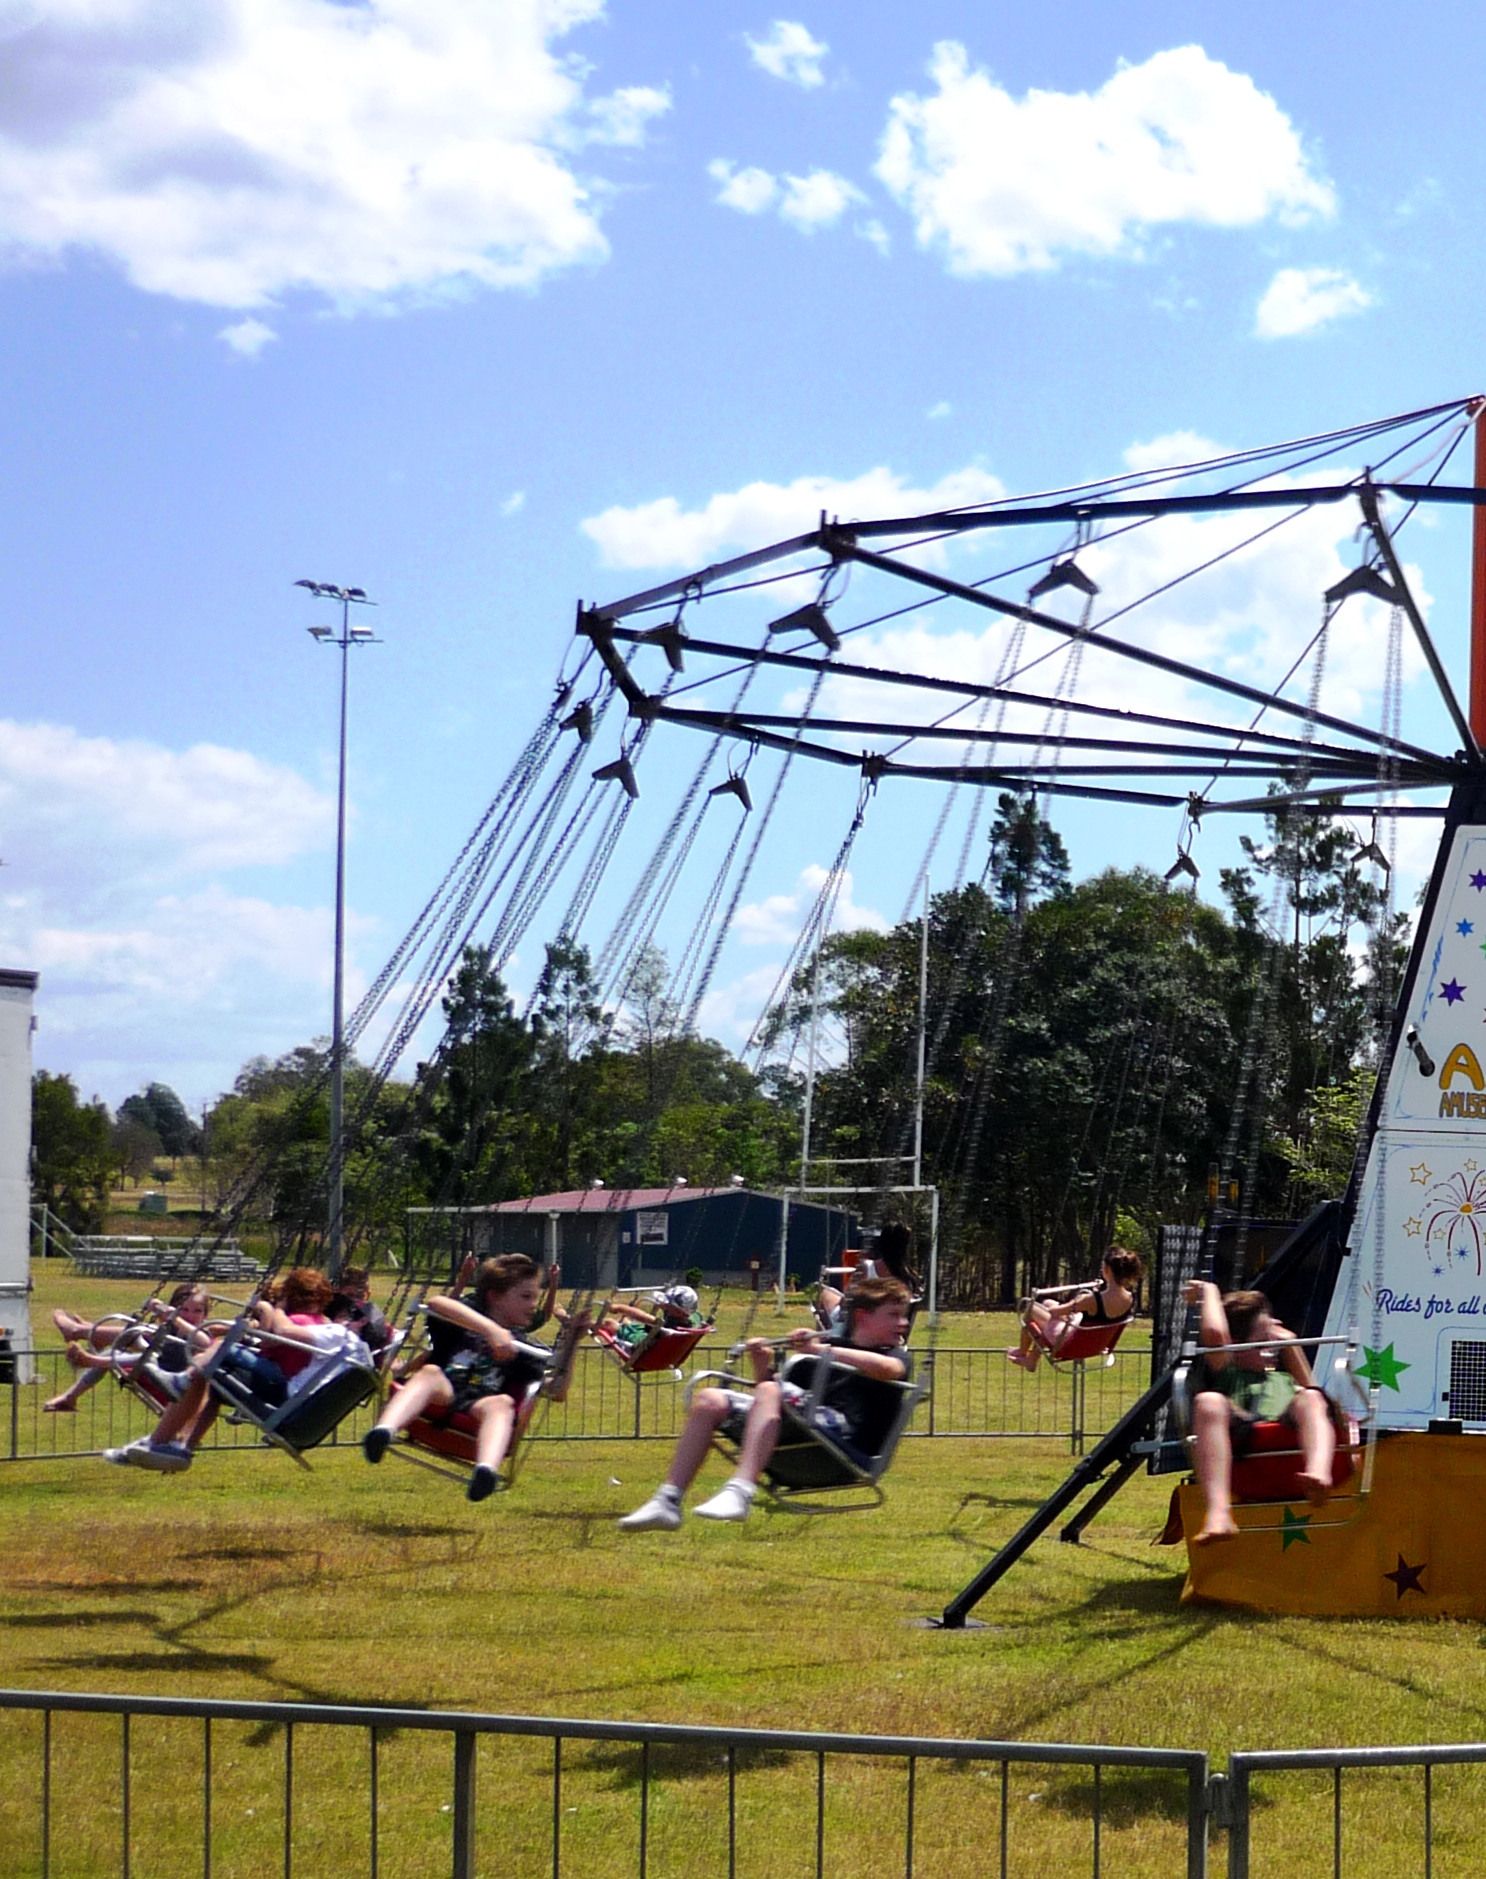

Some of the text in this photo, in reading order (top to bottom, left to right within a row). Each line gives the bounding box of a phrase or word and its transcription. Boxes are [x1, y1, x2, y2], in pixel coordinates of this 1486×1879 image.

[1378, 1288, 1421, 1314] Rides
[1424, 1294, 1454, 1319] for
[1457, 1295, 1481, 1314] all
